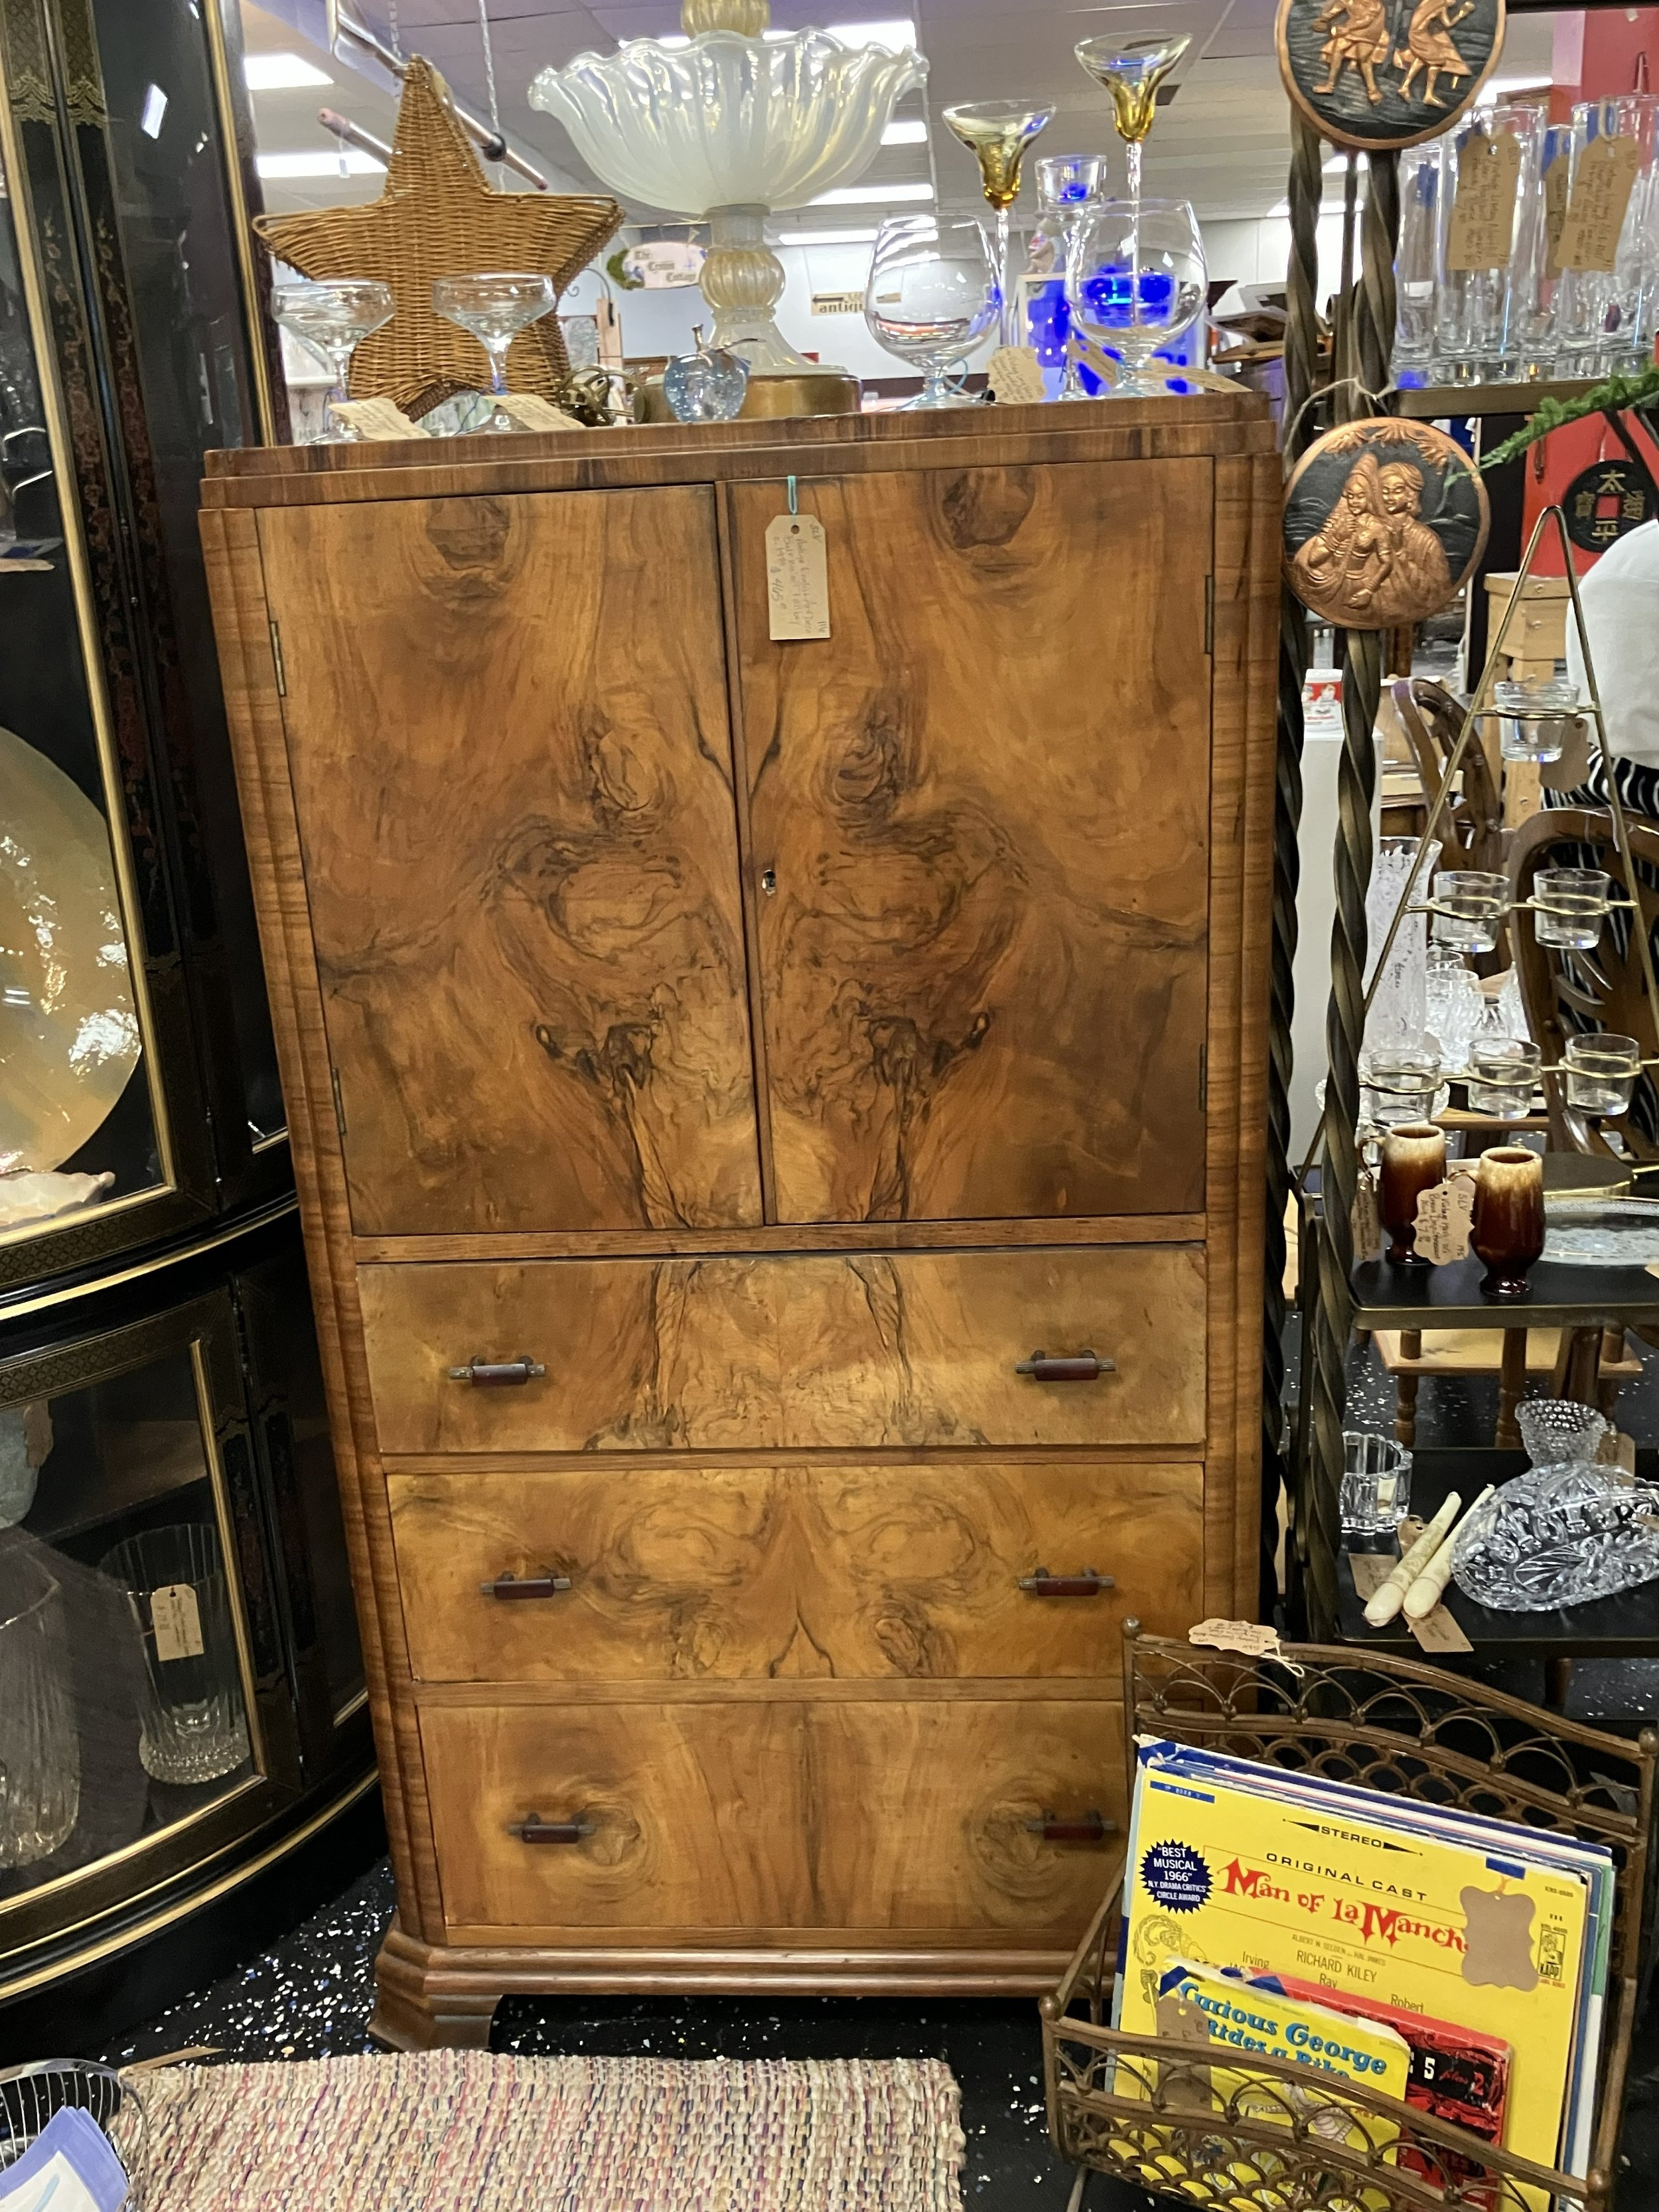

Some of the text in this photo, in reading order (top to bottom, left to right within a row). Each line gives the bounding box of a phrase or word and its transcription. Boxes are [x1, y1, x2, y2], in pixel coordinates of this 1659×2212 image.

[1321, 1826, 1382, 1848] STEREO
[1153, 1858, 1198, 1871] MUSICAL
[1160, 1881, 1181, 1890] DRAMA
[1266, 1852, 1427, 1901] ORIGINAL CAST
[1157, 1891, 1200, 1903] CIRCLE AWARD
[1216, 1857, 1290, 1902] Man
[1356, 1900, 1469, 1954] Manch
[1242, 1951, 1269, 1970] Irving
[1296, 1949, 1378, 1983] RICHARD KILEY
[1390, 1993, 1424, 2014] Robert
[1285, 2022, 1388, 2075] George
[1423, 2057, 1435, 2080] 5
